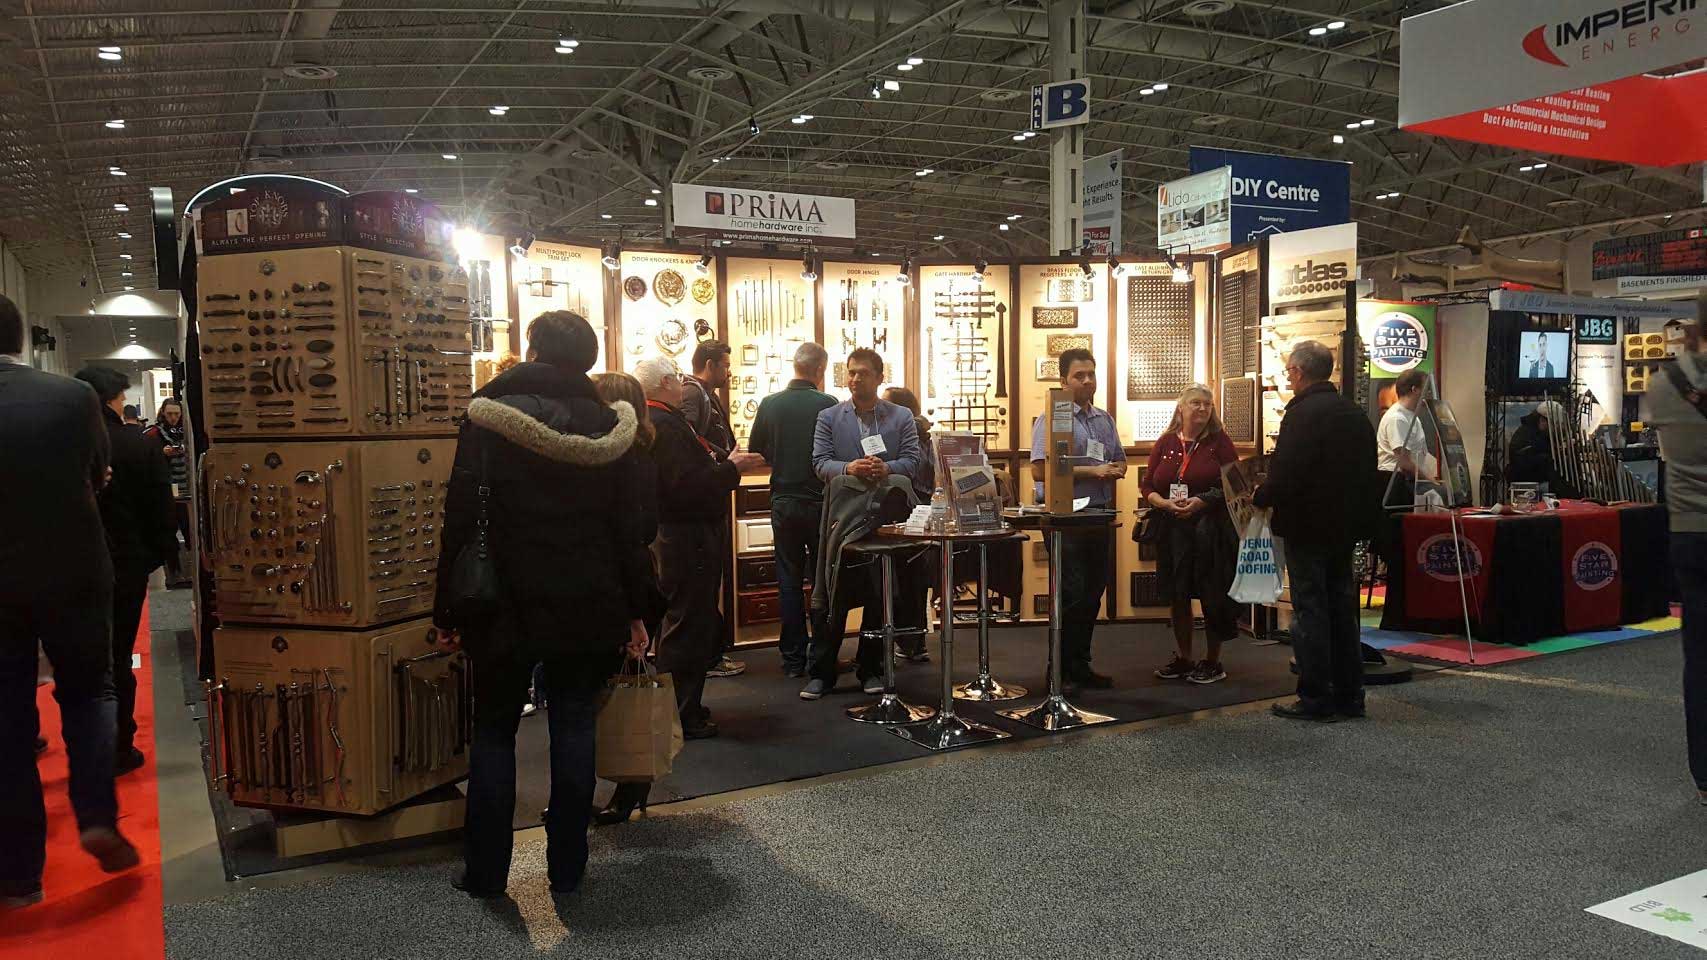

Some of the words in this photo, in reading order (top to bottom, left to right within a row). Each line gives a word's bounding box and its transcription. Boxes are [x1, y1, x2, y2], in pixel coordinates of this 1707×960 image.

[1033, 85, 1042, 129] HALL
[1048, 82, 1088, 122] B
[1512, 104, 1550, 118] Commercial
[1483, 112, 1500, 124] Duct
[1501, 116, 1542, 132] Fabrication
[1550, 124, 1590, 140] Installation
[1232, 178, 1262, 198] DIY
[1266, 180, 1320, 206] Centre
[259, 234, 290, 242] PERFECT
[294, 231, 327, 240] OPENING
[360, 232, 378, 241] STYLE
[1621, 278, 1664, 288] BASEMENTS
[1666, 274, 1702, 284] FINISHED
[1378, 326, 1416, 336] FIVE
[1579, 318, 1613, 337] JBG
[1376, 336, 1418, 346] STAR
[1370, 347, 1423, 358] PAINTING
[1240, 551, 1269, 562] ROAD
